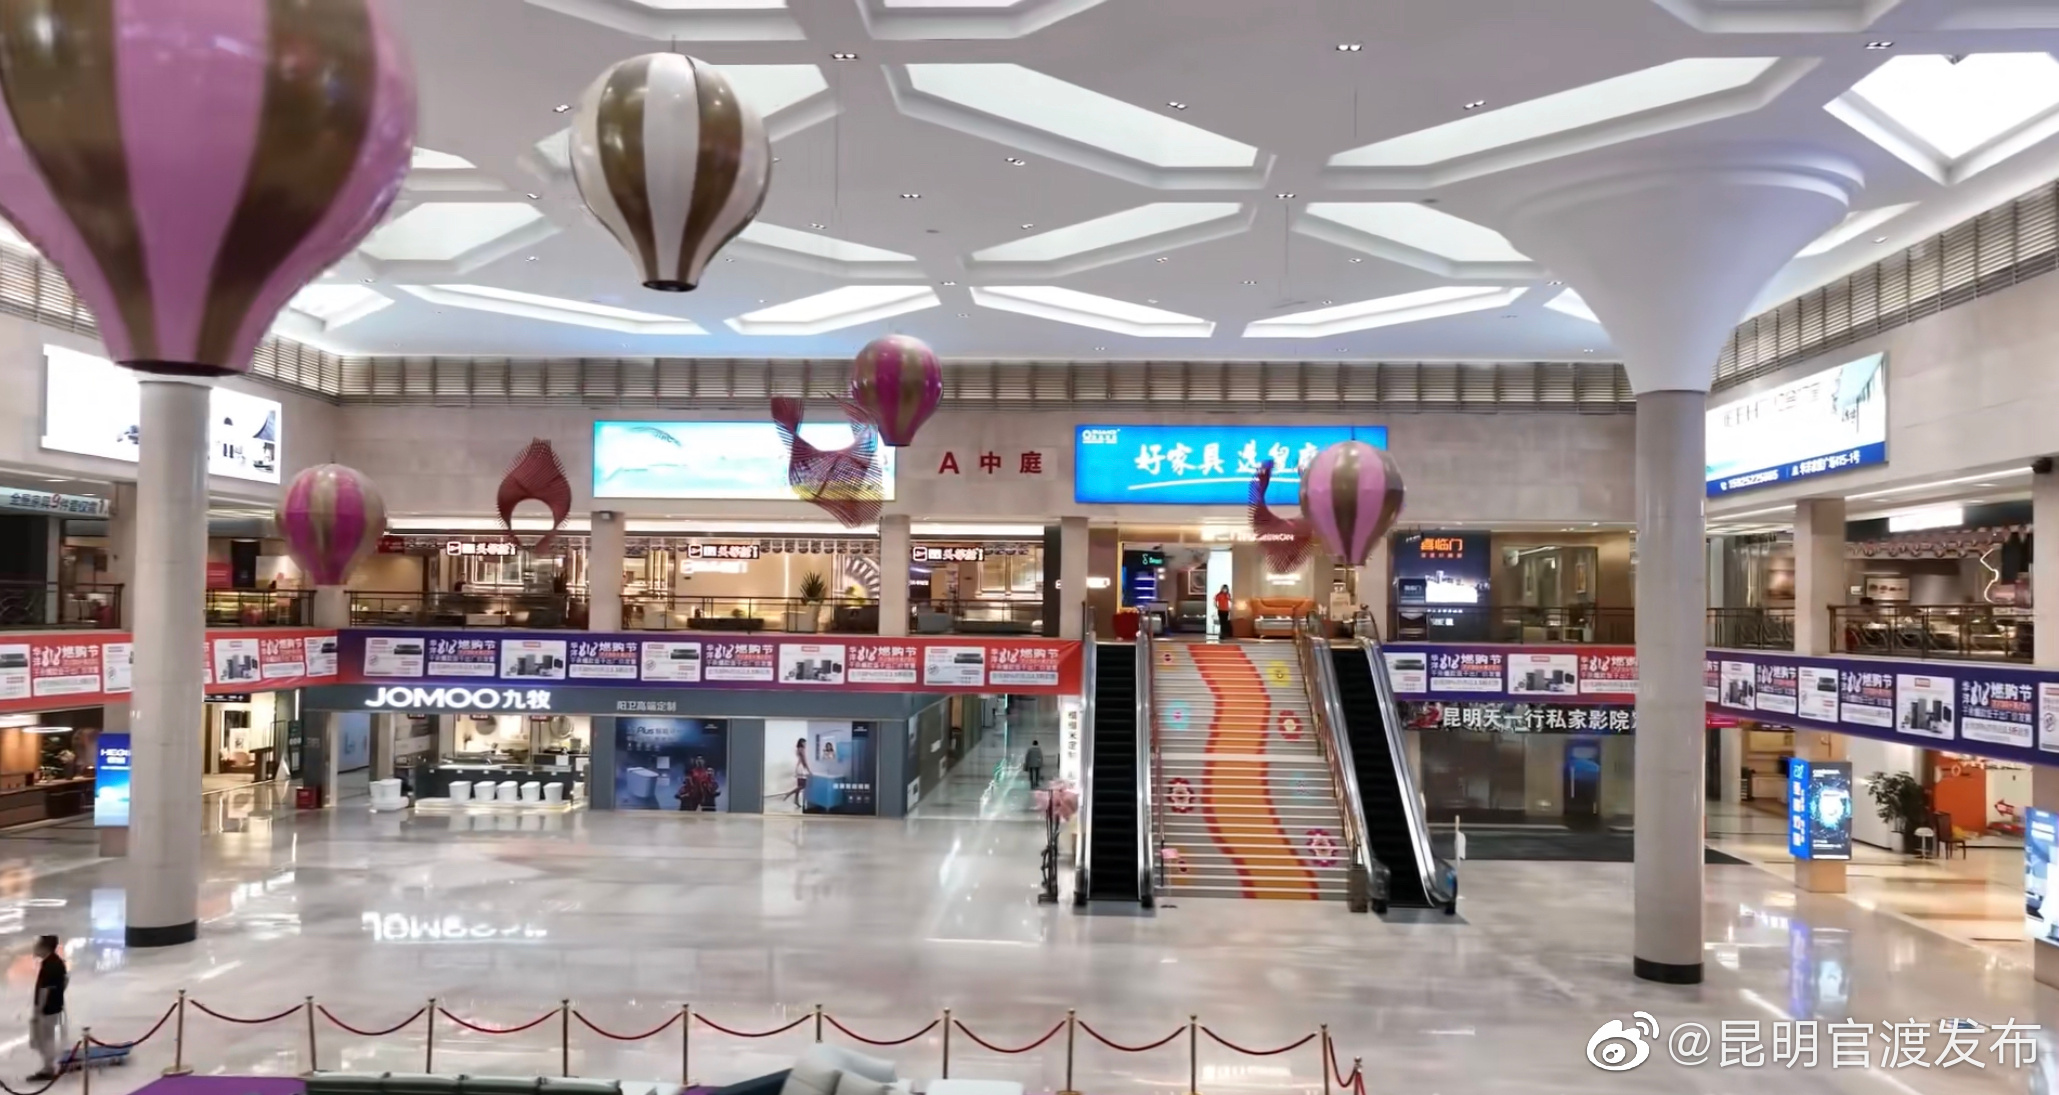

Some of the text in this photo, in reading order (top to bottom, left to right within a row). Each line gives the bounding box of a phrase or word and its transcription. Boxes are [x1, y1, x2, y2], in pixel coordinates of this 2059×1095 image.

[1134, 442, 1223, 476] 好家具
[1421, 538, 1463, 551] 喜临门
[616, 701, 677, 712] 阳卫高端定制
